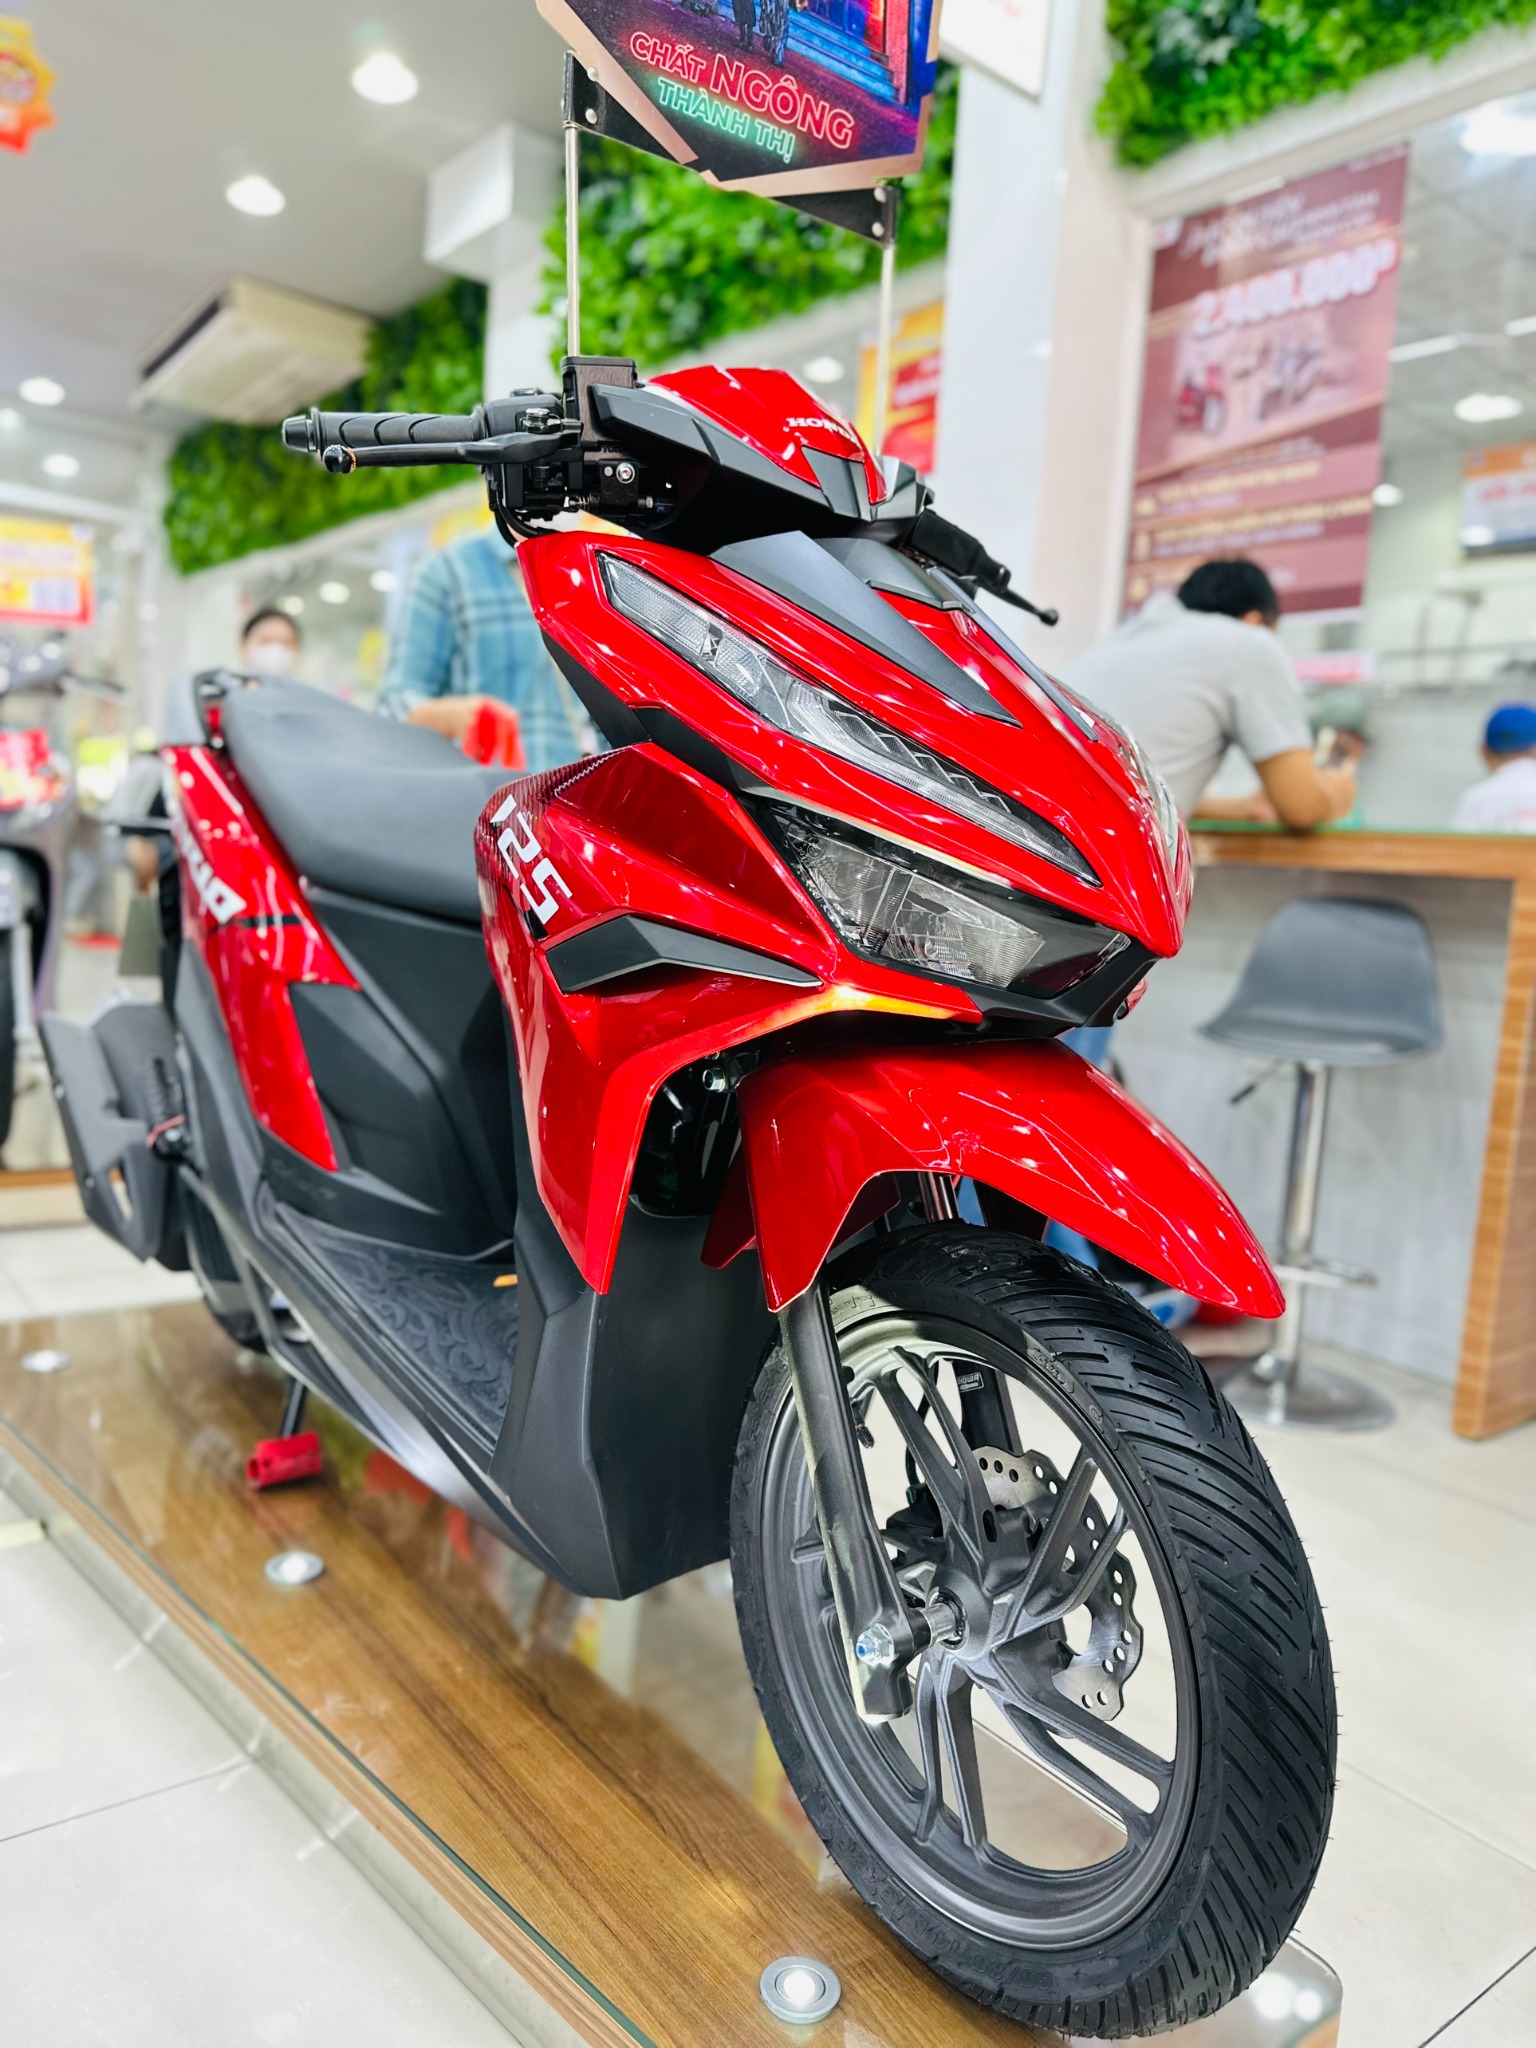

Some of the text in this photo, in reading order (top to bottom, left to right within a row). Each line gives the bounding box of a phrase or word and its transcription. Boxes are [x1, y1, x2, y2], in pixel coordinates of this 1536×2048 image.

[630, 31, 855, 149] CHẤT NGÔNG
[657, 77, 796, 163] THÀNH THỊ
[490, 793, 573, 925] 125
